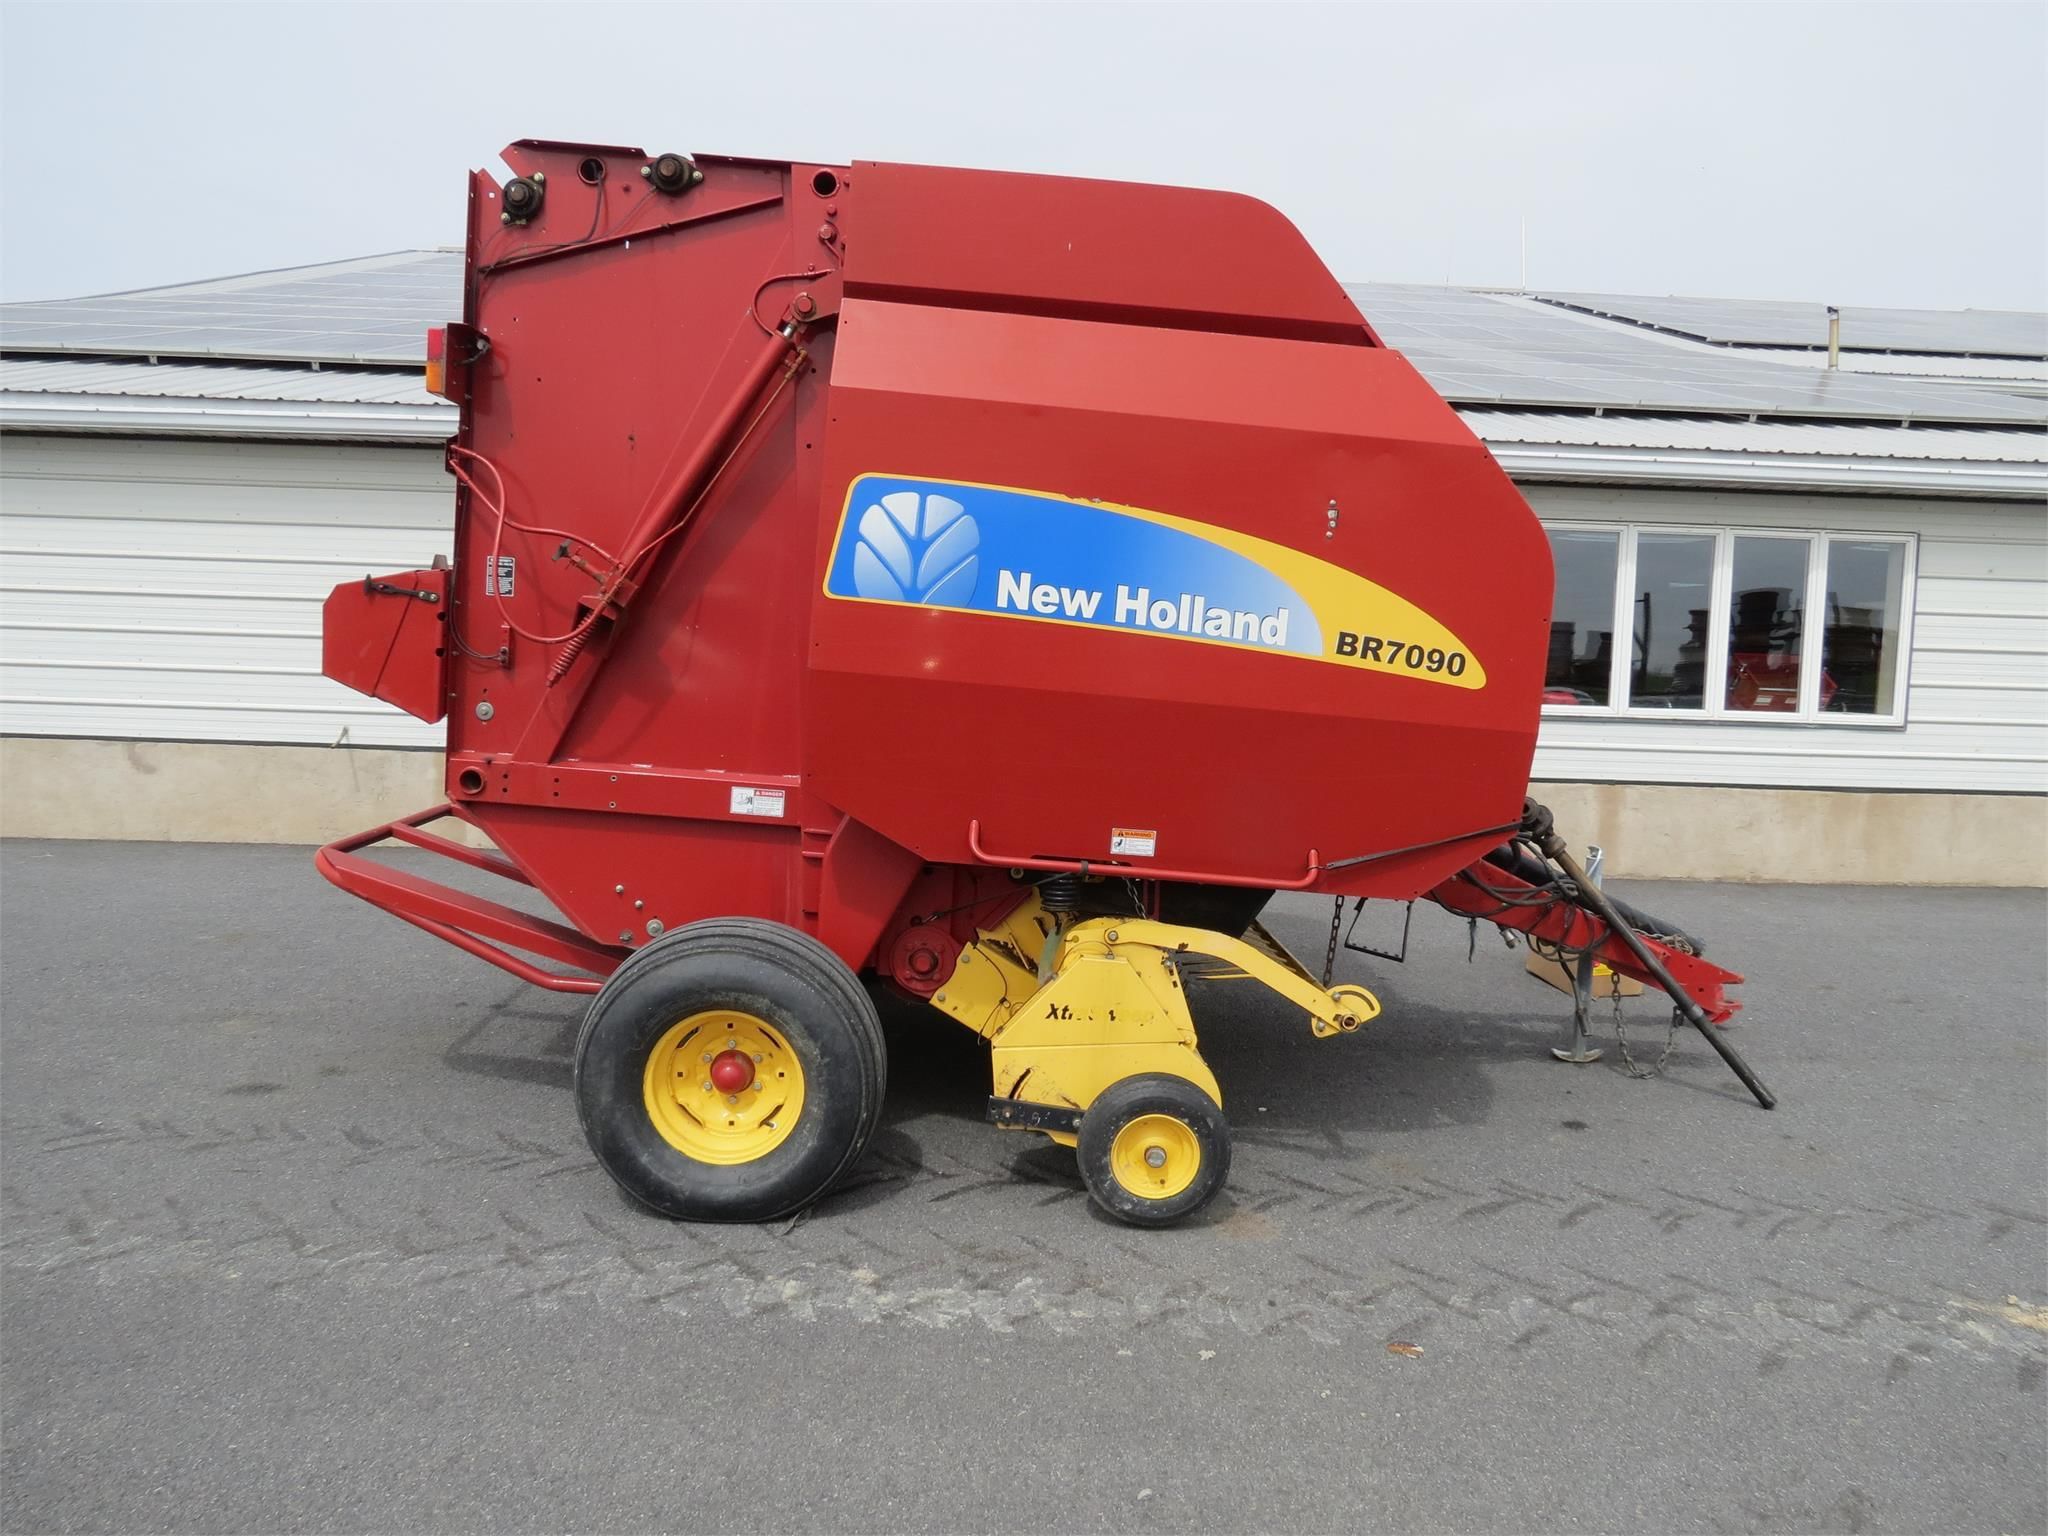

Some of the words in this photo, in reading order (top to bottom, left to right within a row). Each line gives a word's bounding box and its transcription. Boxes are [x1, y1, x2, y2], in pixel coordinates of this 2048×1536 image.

[996, 569, 1102, 618] New
[1114, 585, 1290, 646] Holland
[1335, 631, 1467, 677] BR7090
